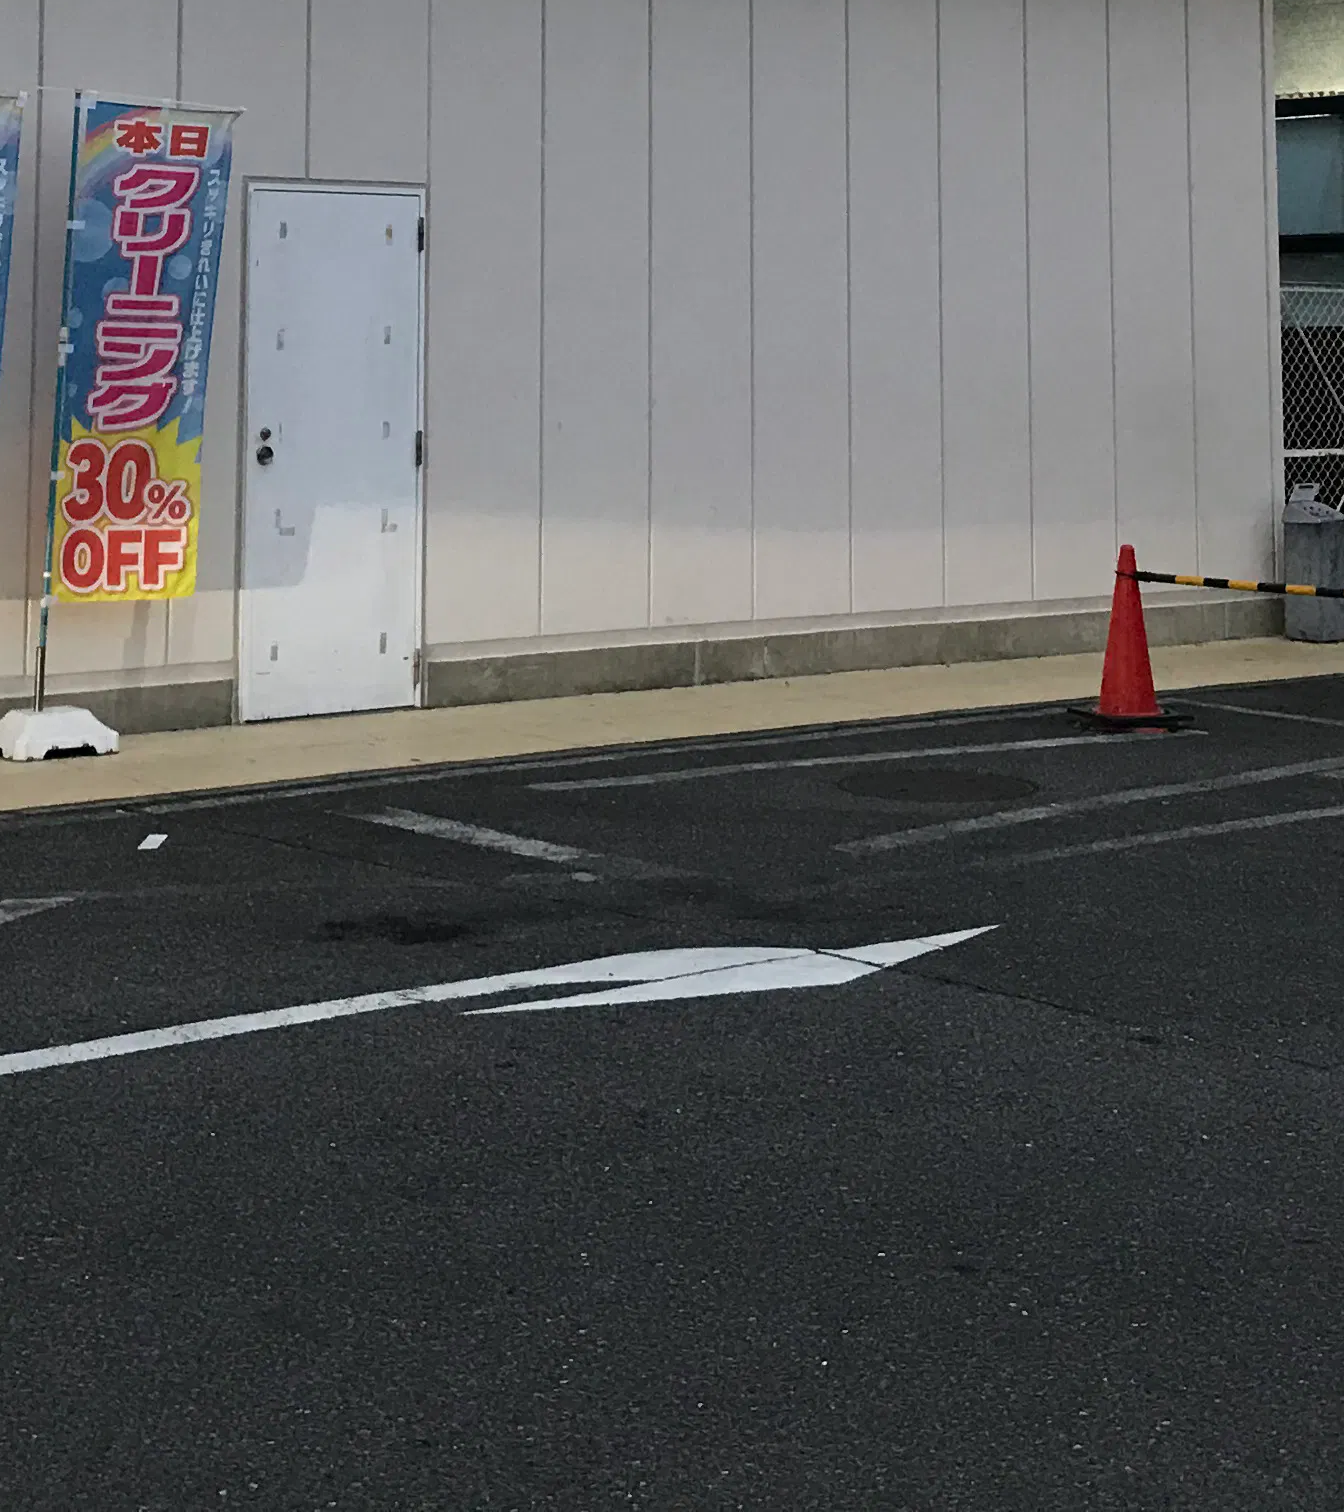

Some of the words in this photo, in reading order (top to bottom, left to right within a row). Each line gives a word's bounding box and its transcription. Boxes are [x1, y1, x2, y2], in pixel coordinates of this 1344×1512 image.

[116, 119, 211, 160] 本日
[86, 163, 202, 431] クリーニング
[61, 439, 191, 525] 30%
[59, 525, 188, 591] OFF
